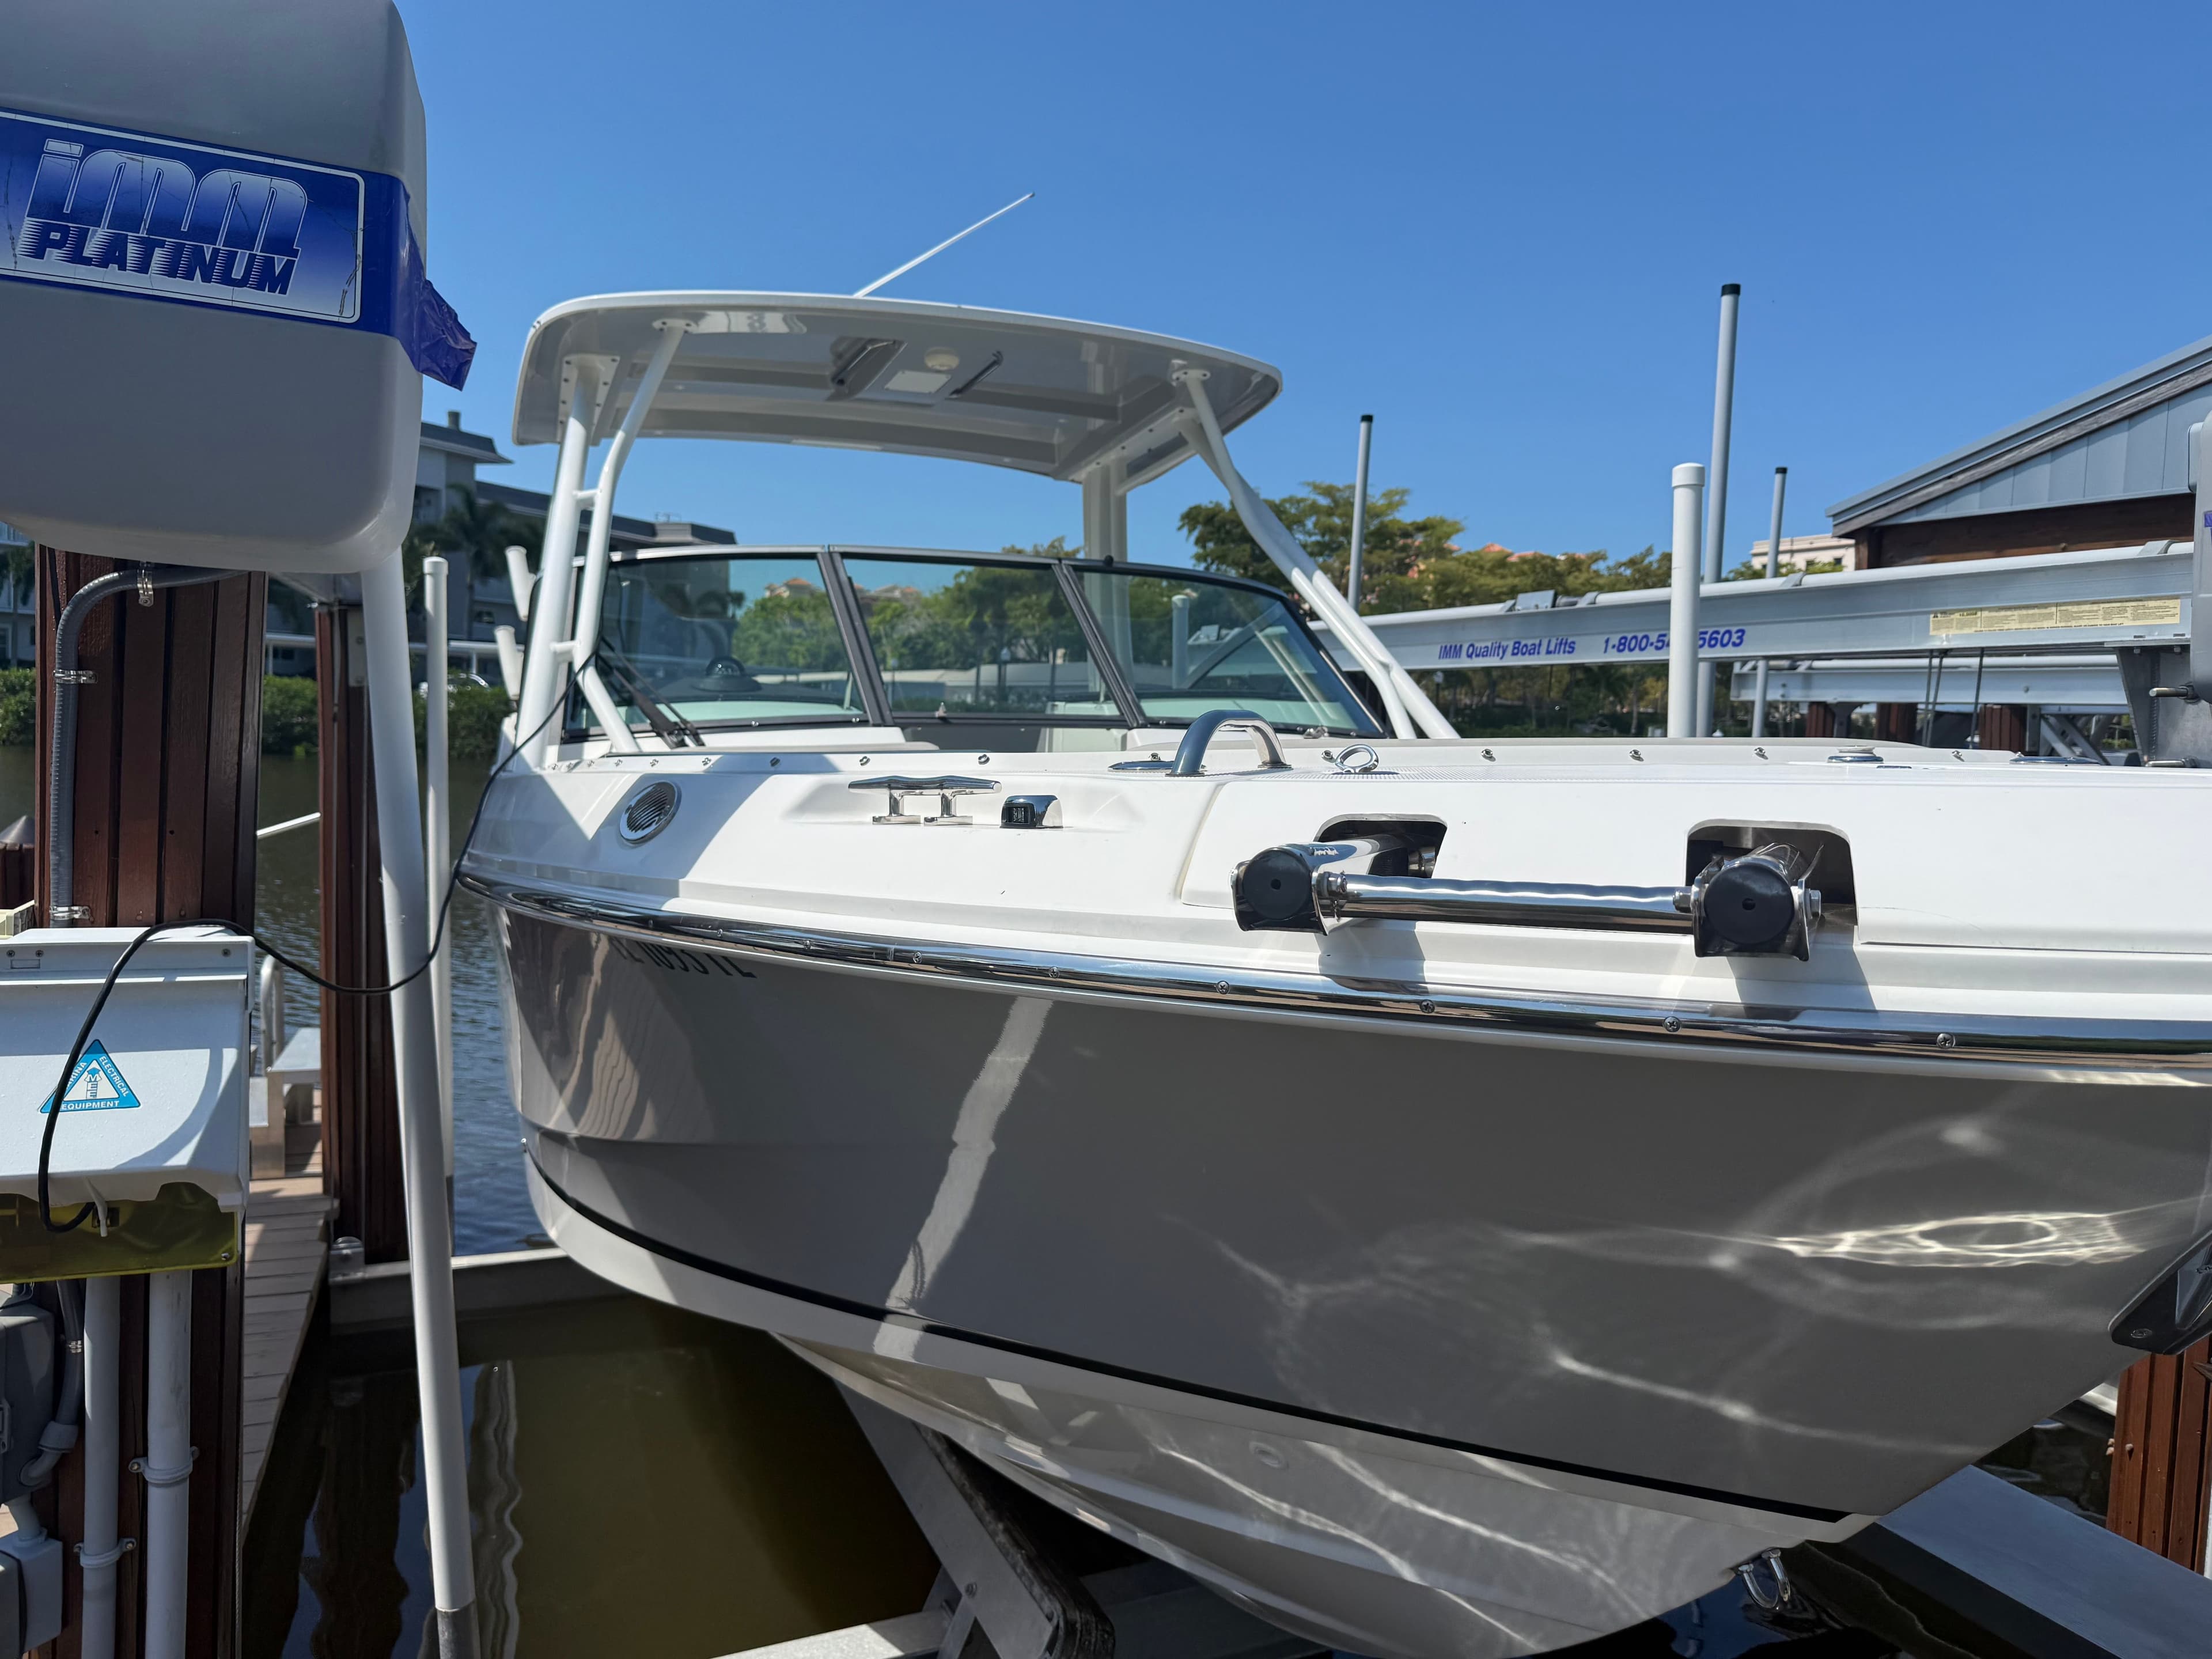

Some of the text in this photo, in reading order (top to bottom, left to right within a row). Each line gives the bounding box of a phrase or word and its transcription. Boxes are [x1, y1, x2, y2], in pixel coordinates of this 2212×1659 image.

[17, 218, 298, 296] PLATINUM
[1438, 628, 1745, 660] IMM Quality Boat Lifts 1-800-55603
[99, 1056, 129, 1097] ELECTRICAL
[62, 1100, 119, 1110] EQUIPMENT
